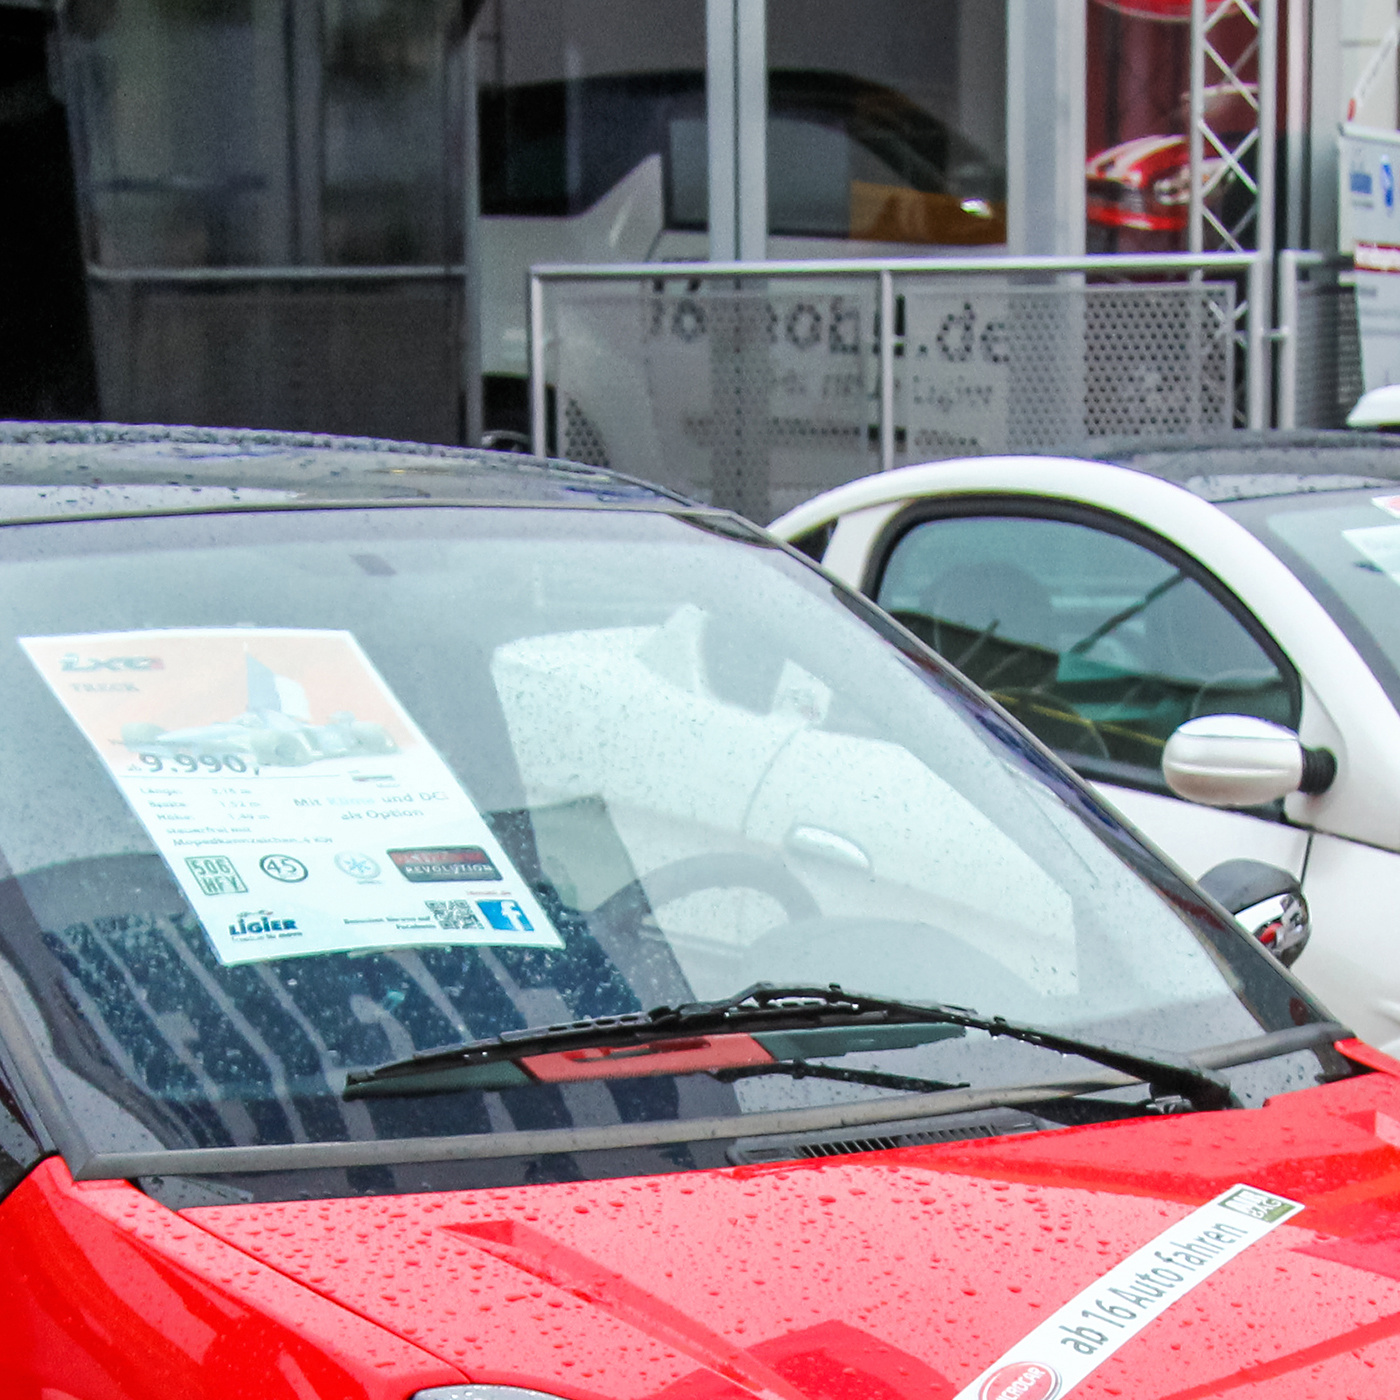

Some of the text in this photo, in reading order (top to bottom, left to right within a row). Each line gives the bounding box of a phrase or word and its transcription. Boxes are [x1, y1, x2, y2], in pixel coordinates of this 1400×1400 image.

[292, 797, 323, 807] Mit
[381, 792, 414, 803] und
[340, 808, 425, 821] als Option
[190, 857, 231, 876] 506
[266, 858, 298, 875] 45
[404, 863, 495, 876] REVOLUTION
[1060, 1221, 1250, 1357] ab 16 Auto fahren
